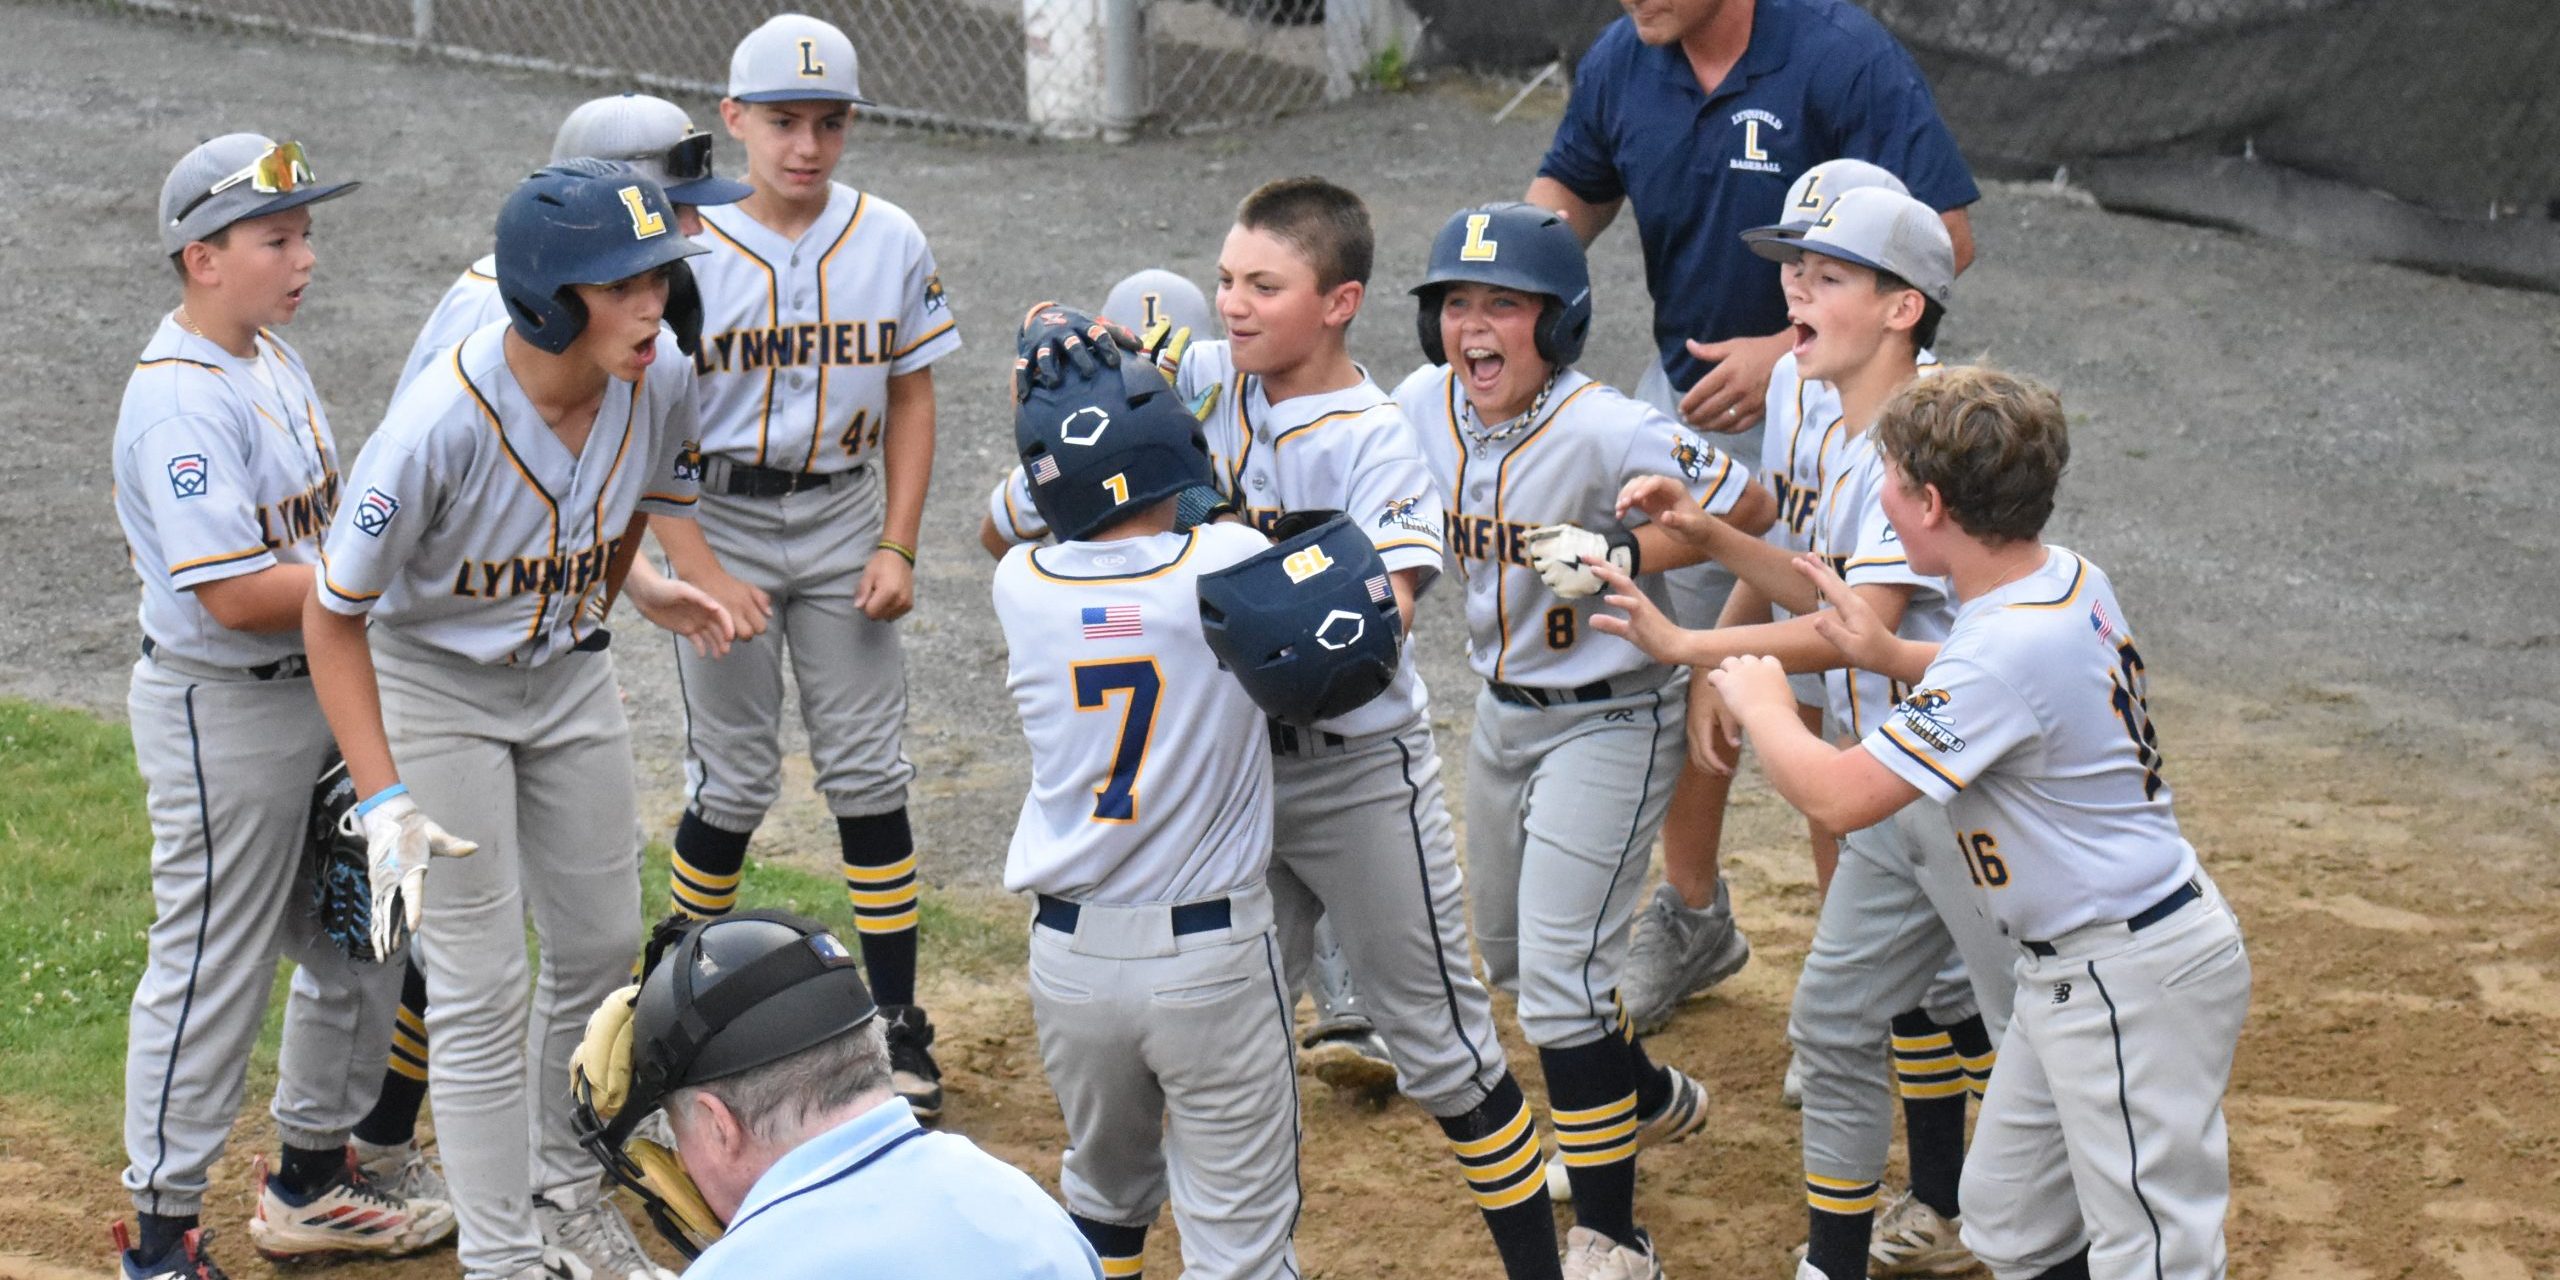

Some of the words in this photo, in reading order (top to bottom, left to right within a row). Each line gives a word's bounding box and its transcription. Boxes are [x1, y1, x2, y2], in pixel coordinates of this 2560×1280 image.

[796, 38, 827, 79] L
[1745, 119, 1768, 161] L
[1729, 158, 1782, 173] BASEBALL
[617, 185, 667, 240] L
[1795, 172, 1823, 210] L
[1461, 213, 1498, 261] L
[693, 320, 898, 377] LYNNFIELD
[1102, 472, 1130, 506] 7
[1282, 544, 1335, 585] 15
[1545, 603, 1577, 654] 8
[1069, 655, 1167, 825] 7
[1957, 828, 2011, 888] 16
